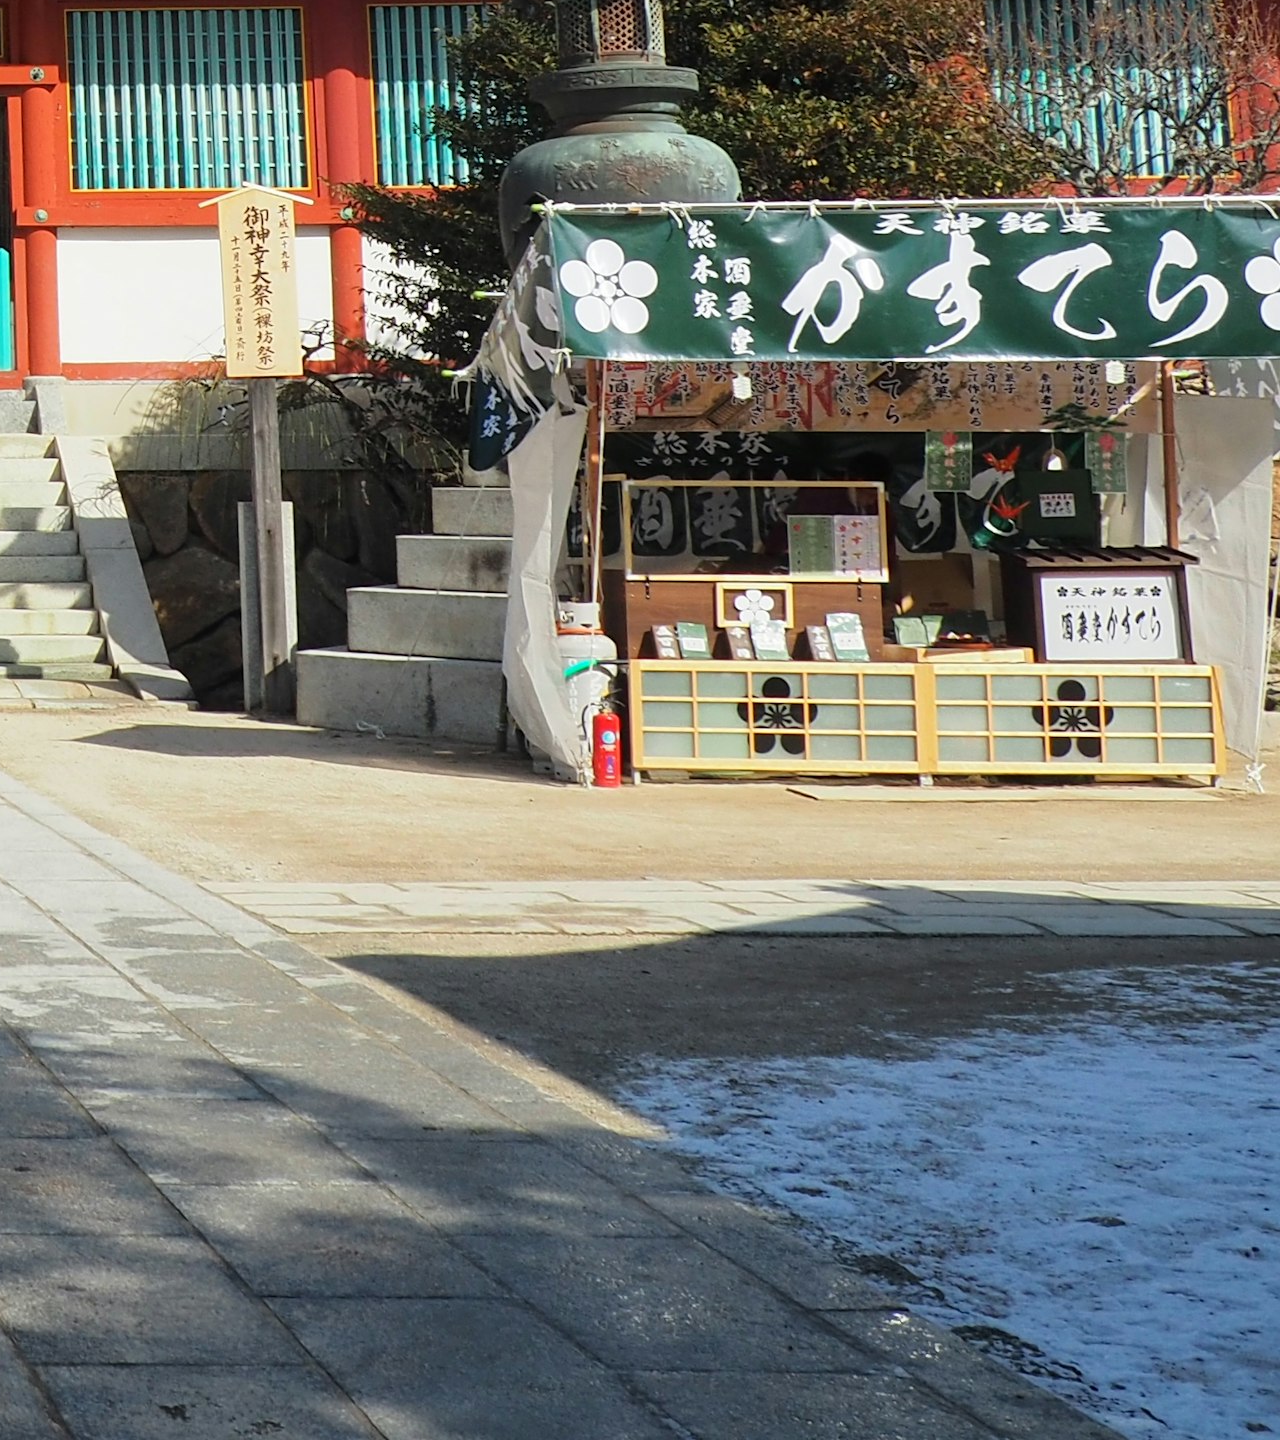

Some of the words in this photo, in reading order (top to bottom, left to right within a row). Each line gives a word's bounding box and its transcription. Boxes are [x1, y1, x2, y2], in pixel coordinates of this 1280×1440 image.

[276, 203, 291, 273] 平成二十九年
[872, 210, 1114, 235] 天神銘菓
[686, 218, 722, 321] 総本家
[780, 228, 1230, 355] かすてら
[723, 257, 757, 357] 酒垂堂
[652, 430, 773, 456] 総本家
[1070, 586, 1149, 598] 天神銘菓
